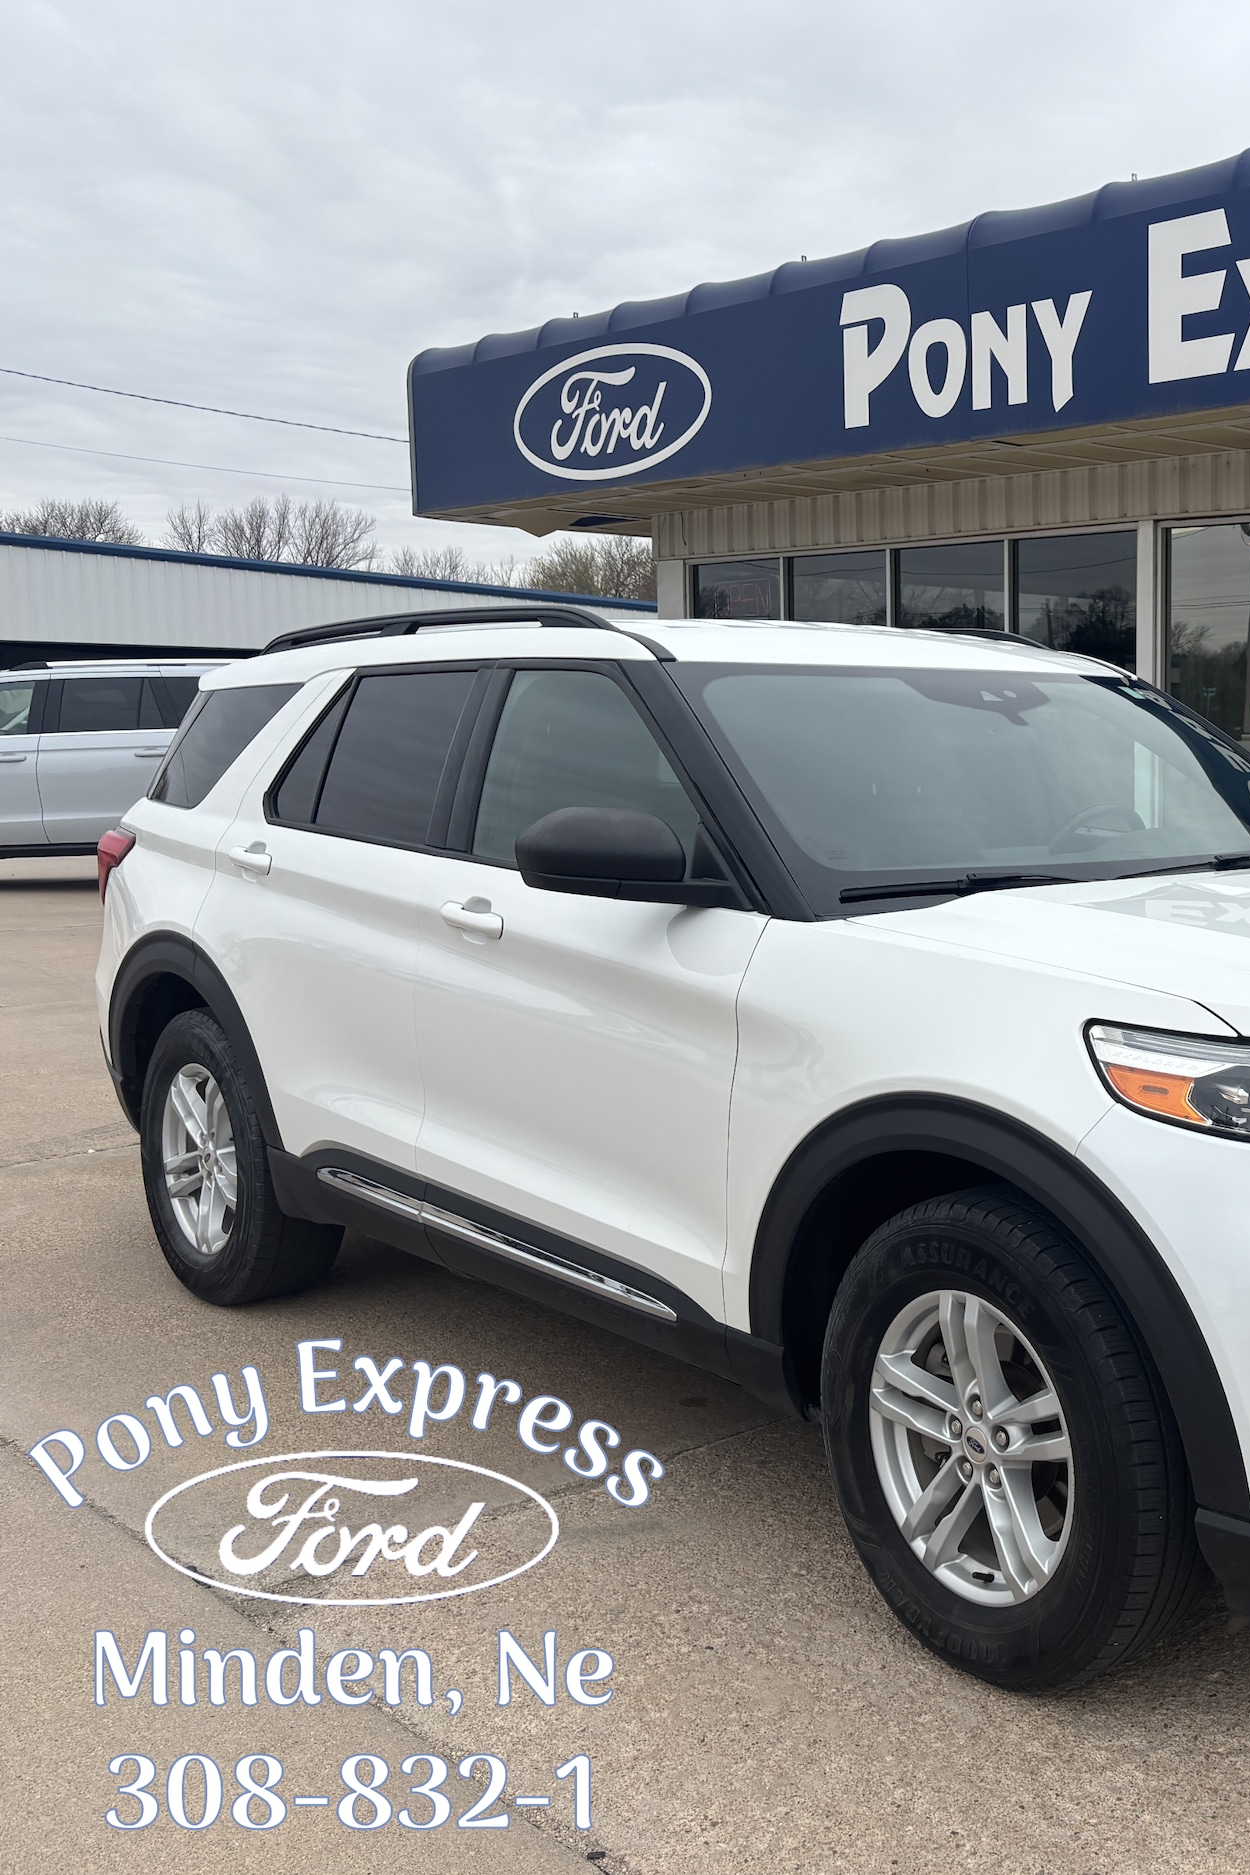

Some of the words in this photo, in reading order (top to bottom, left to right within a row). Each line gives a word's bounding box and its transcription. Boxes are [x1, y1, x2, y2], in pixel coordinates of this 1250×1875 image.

[838, 282, 1093, 429] PONY
[550, 366, 667, 461] Ford
[716, 582, 769, 617] OPEN
[901, 1241, 1037, 1319] ASSURANCE
[968, 1438, 982, 1452] Ford
